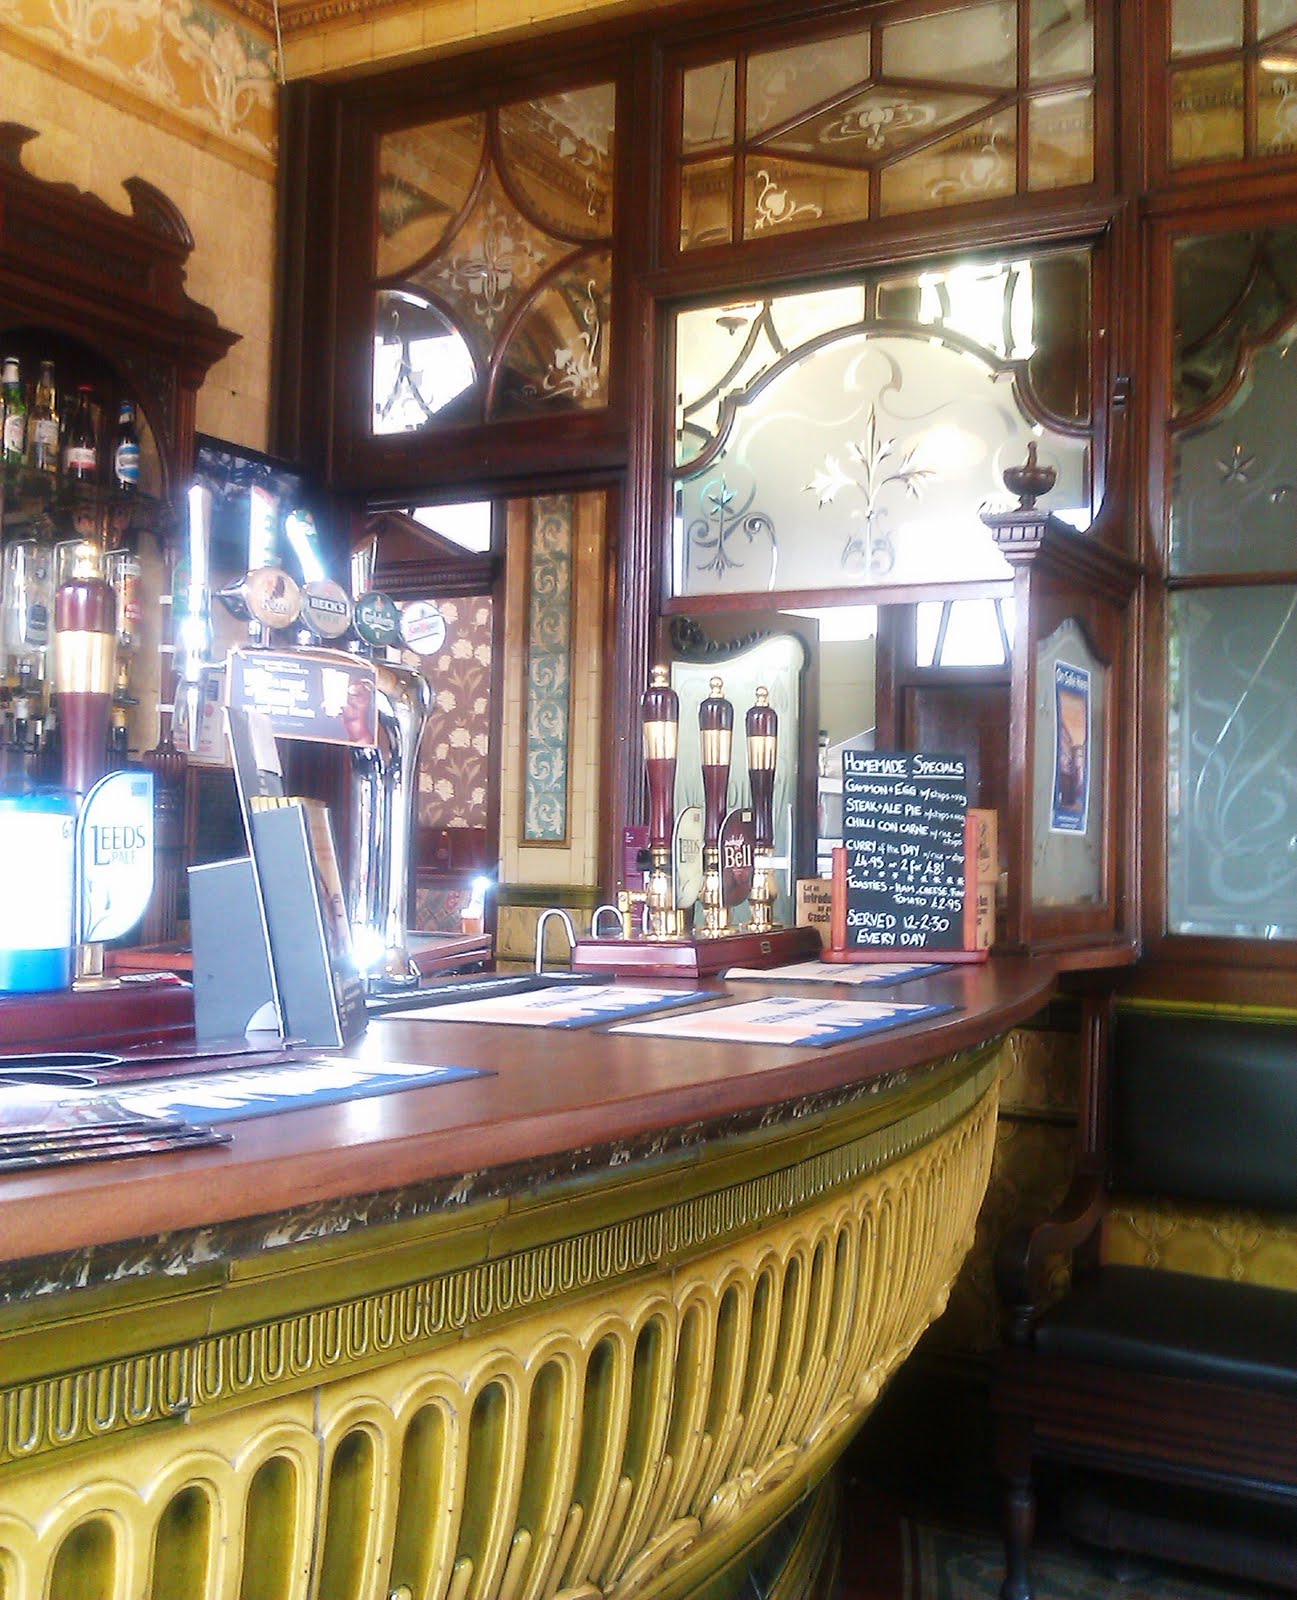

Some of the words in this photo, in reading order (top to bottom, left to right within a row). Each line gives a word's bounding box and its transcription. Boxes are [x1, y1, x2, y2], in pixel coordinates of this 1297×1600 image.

[844, 751, 907, 773] HOMEMADE
[912, 754, 964, 774] SPECIALS
[905, 803, 922, 816] PIE
[845, 816, 875, 828] CHILLI
[877, 820, 899, 833] CON
[899, 824, 929, 836] CARNE
[724, 846, 752, 869] Bell
[845, 839, 877, 853] CURRY
[901, 843, 920, 857] DAY
[900, 858, 908, 871] 2
[892, 894, 927, 905] TOMATO
[846, 908, 897, 929] SERVED
[856, 928, 896, 945] EVERY
[900, 932, 926, 947] DAY
